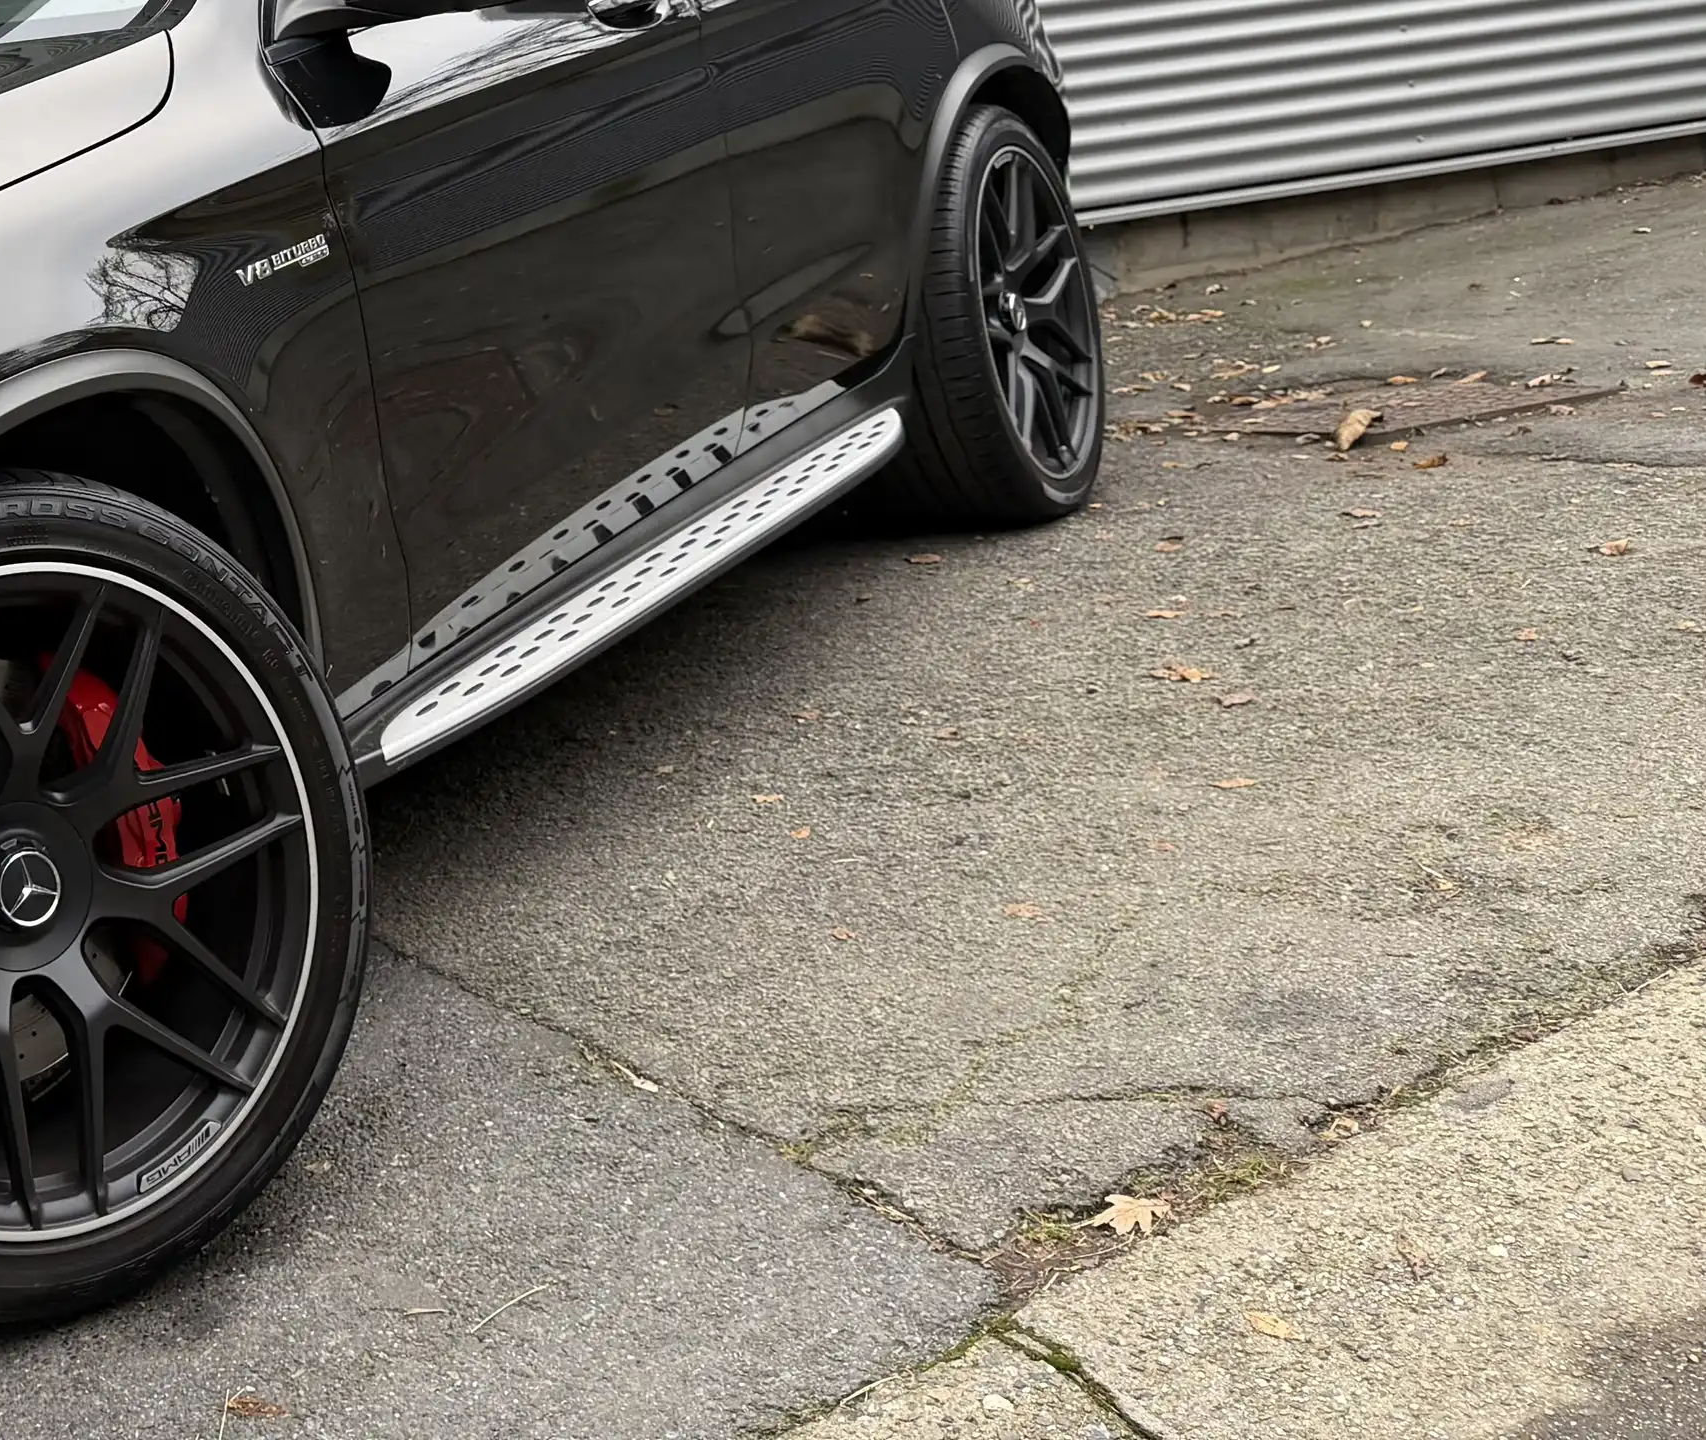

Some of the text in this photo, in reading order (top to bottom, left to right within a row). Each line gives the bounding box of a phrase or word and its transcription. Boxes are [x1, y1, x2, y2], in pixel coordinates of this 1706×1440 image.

[236, 258, 272, 287] V8
[271, 233, 326, 266] BITURBO
[138, 522, 313, 681] CONTACT
